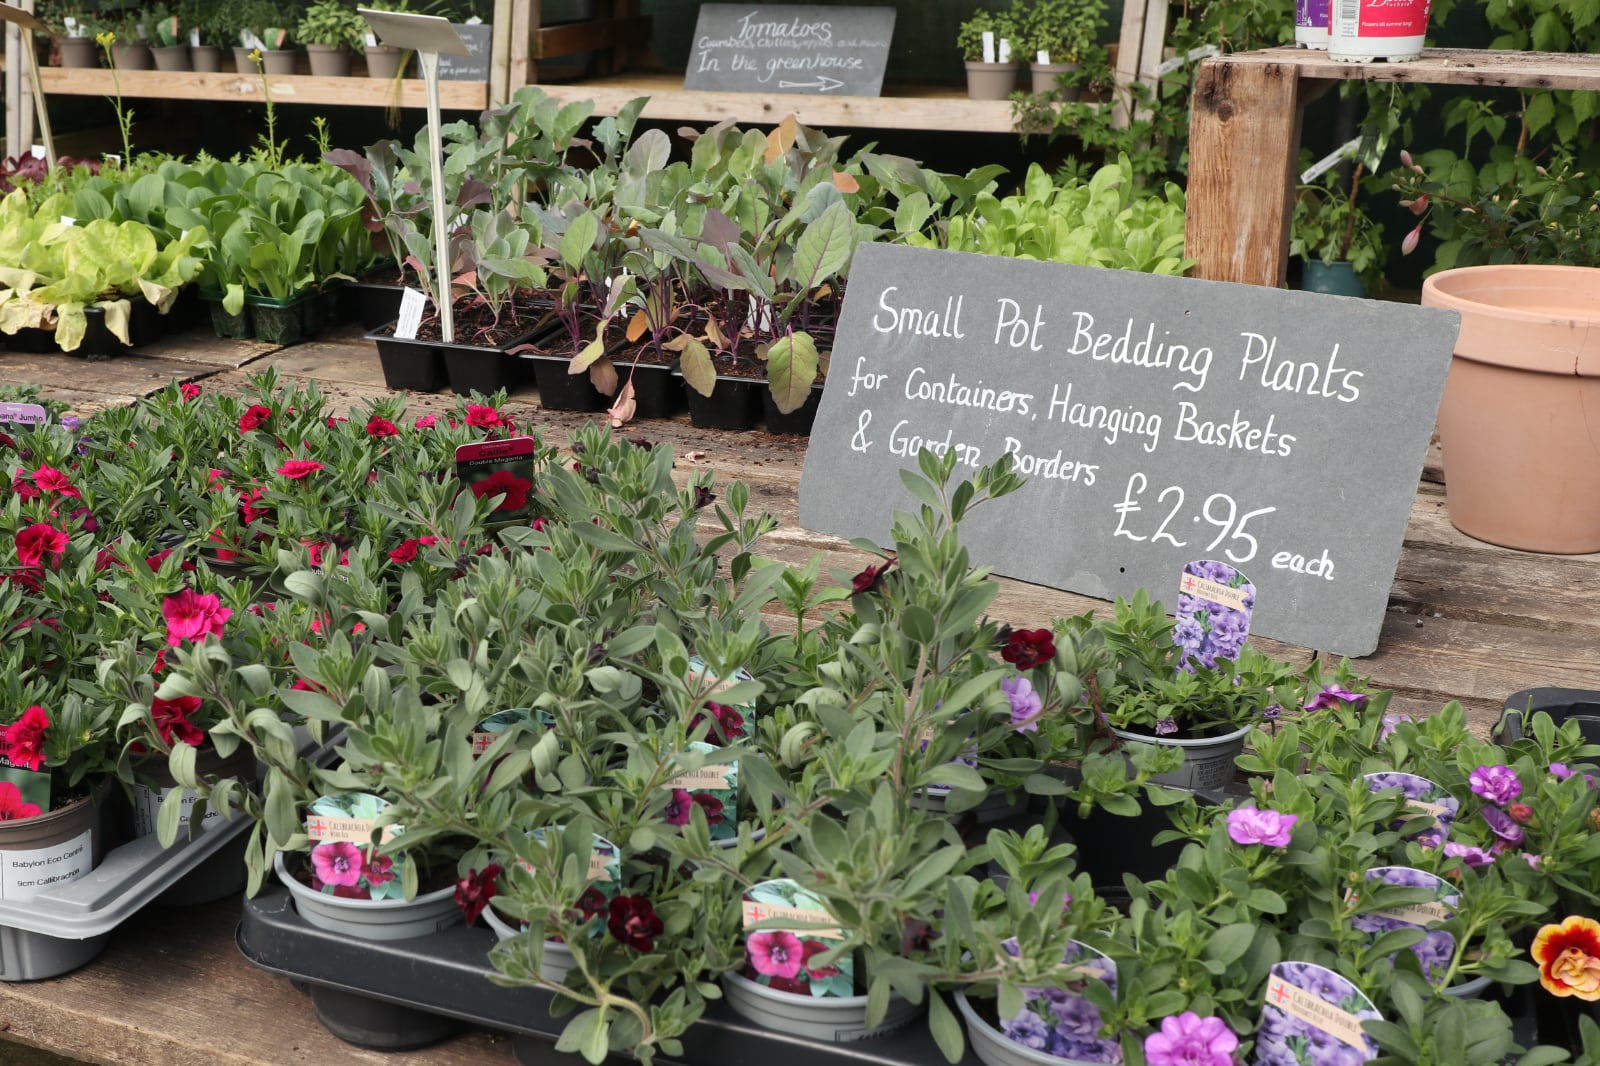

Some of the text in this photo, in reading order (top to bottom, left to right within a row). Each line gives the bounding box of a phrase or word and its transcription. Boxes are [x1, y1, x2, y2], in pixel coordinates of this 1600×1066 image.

[738, 11, 832, 40] Tomatoes
[697, 51, 864, 83] In the greenhouse
[873, 286, 1364, 402] Small Pot Bedding Plants
[847, 356, 1296, 456] for Containers, Hanging Baskets
[469, 455, 523, 466] Double Magenta
[851, 409, 1100, 486] & Garden Borders
[1271, 549, 1334, 581] each
[12, 861, 46, 869] Babylon
[47, 856, 62, 865] Eco
